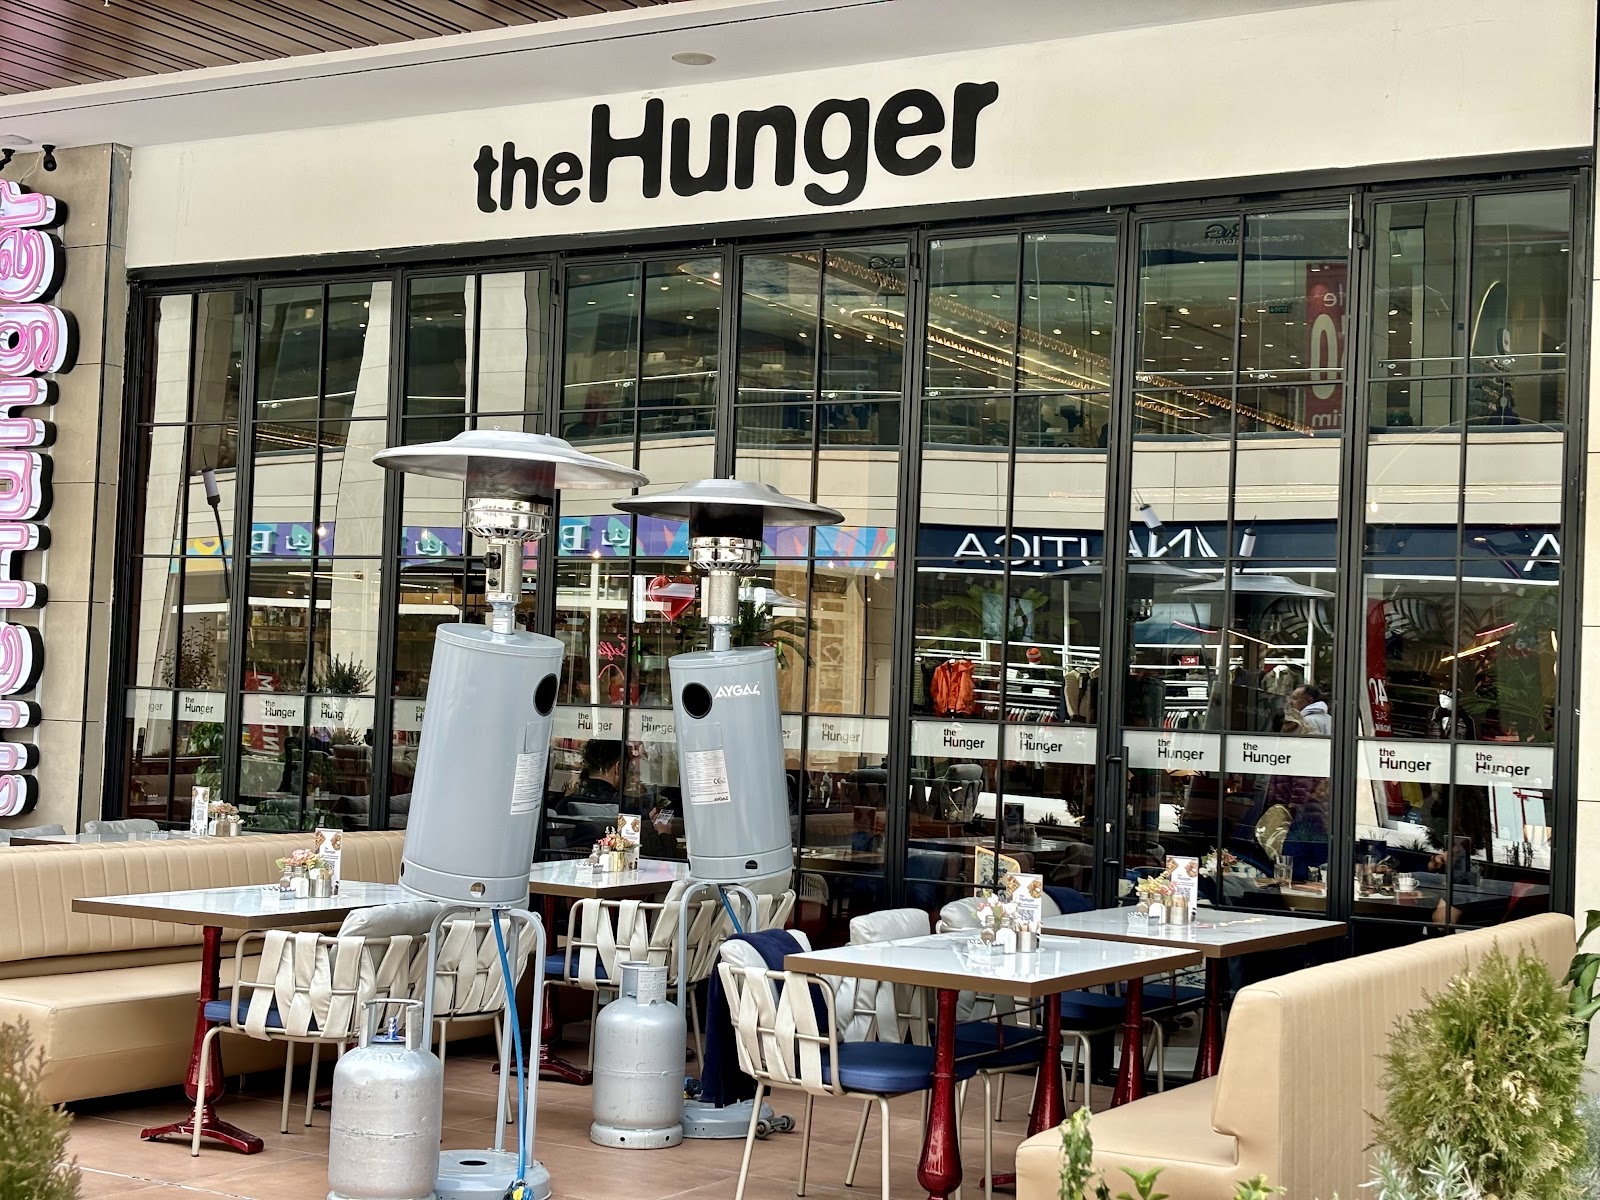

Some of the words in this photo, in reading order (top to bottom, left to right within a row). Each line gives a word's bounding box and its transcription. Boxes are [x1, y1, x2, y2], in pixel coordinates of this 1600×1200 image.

[185, 696, 195, 704] the
[185, 703, 214, 714] Hunger
[265, 707, 296, 719] Hunger
[321, 709, 344, 721] Hung
[641, 714, 653, 722] the
[578, 719, 613, 732] Huger
[822, 722, 835, 730] the
[821, 730, 861, 743] Hunger
[943, 728, 957, 737] the
[1019, 731, 1033, 740] the
[943, 736, 985, 750] Hunger
[1019, 739, 1063, 753] Hunger
[1157, 738, 1171, 746] the
[1243, 742, 1258, 750] the
[1243, 750, 1292, 766] Hunger
[1379, 748, 1396, 757] the
[1475, 751, 1493, 761] the
[1379, 756, 1431, 773] Hunger
[1475, 761, 1530, 777] Hunger
